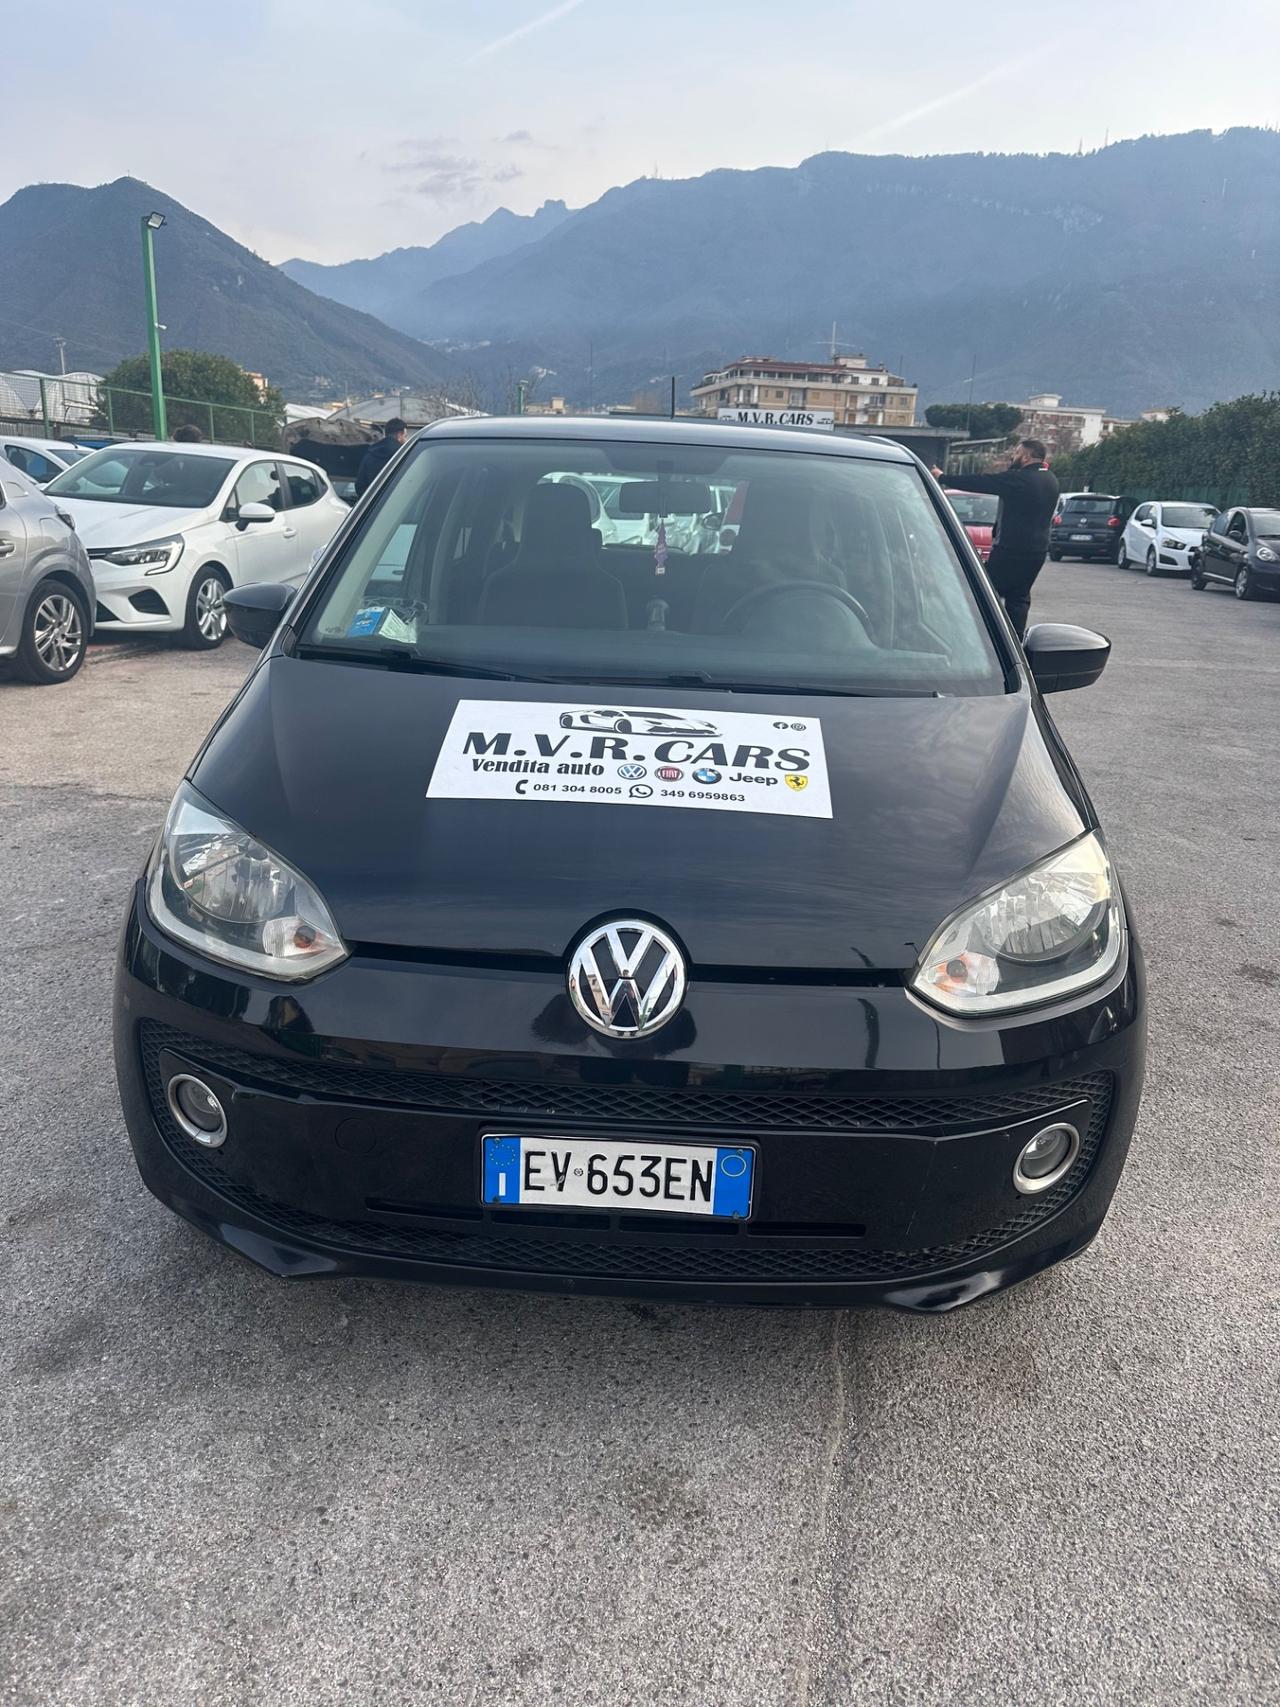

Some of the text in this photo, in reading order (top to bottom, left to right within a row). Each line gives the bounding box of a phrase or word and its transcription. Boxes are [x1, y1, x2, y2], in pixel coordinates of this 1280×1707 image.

[472, 759, 605, 776] Vendita auto
[661, 769, 679, 779] FIAT
[729, 772, 778, 786] Jeep
[533, 784, 622, 794] 081 304 8005
[660, 789, 745, 801] 349 6959863
